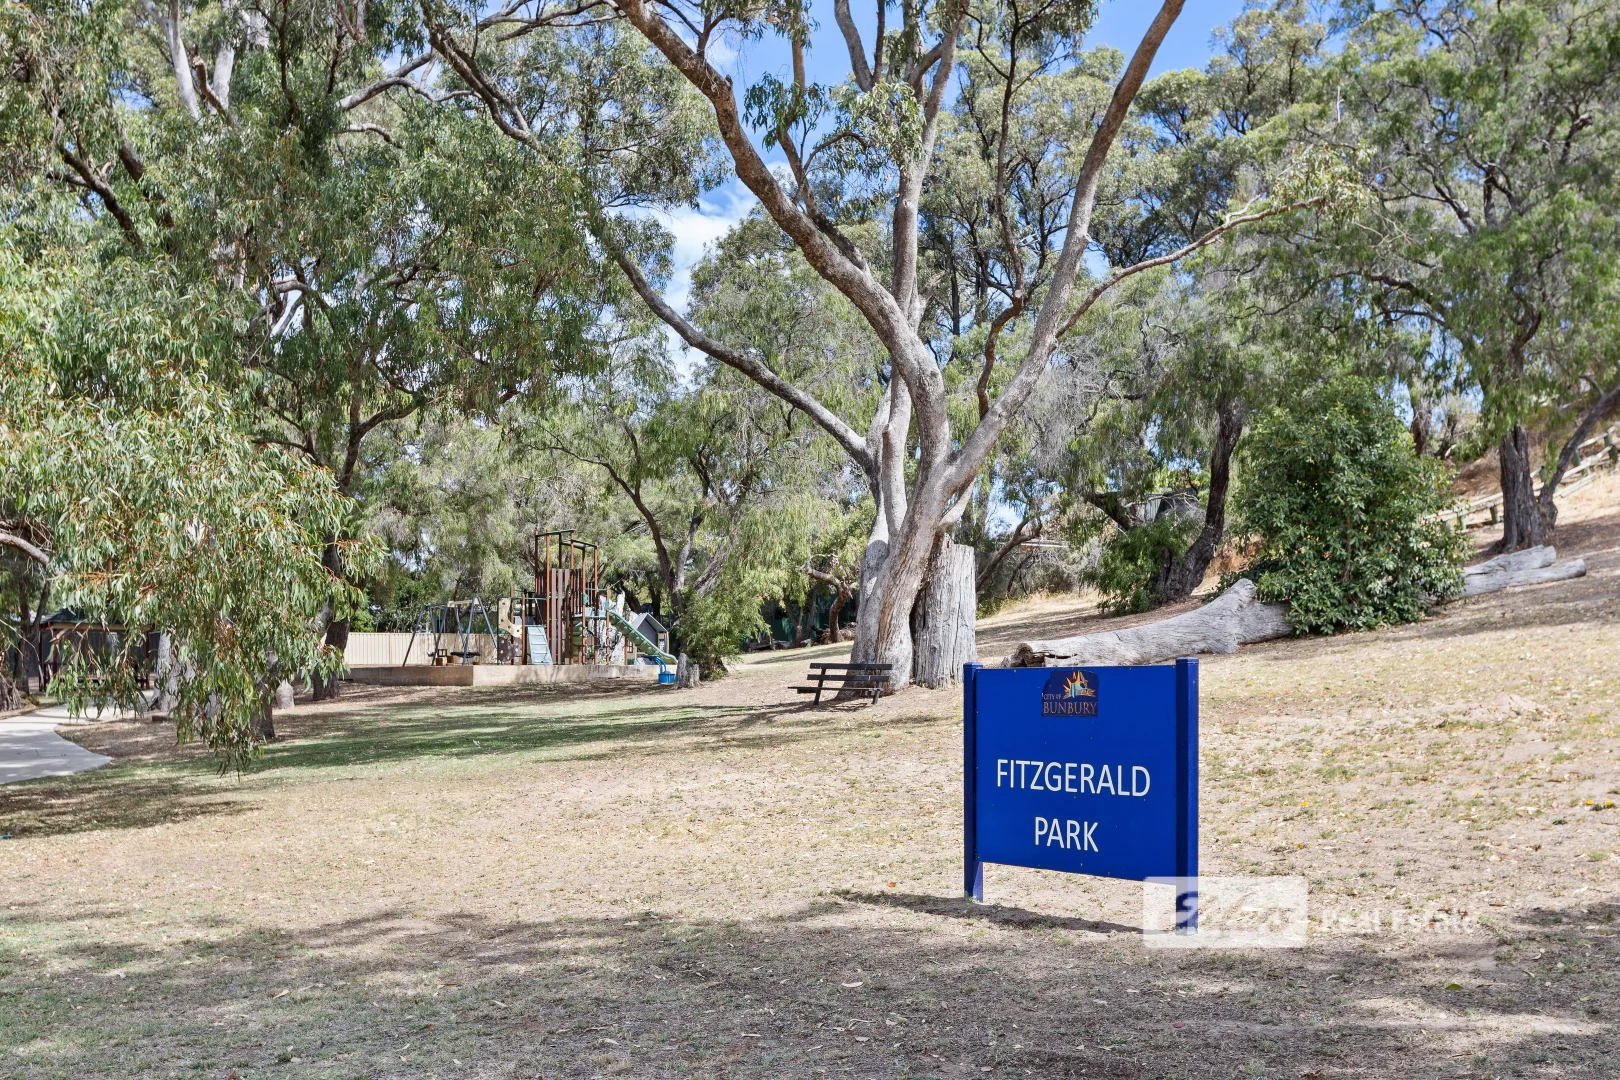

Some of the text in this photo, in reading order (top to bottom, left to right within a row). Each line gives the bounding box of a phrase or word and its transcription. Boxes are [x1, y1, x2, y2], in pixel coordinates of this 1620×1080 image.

[1043, 701, 1097, 715] BUNBURY
[996, 758, 1151, 797] FITZGERALD
[1034, 816, 1099, 852] PARK
